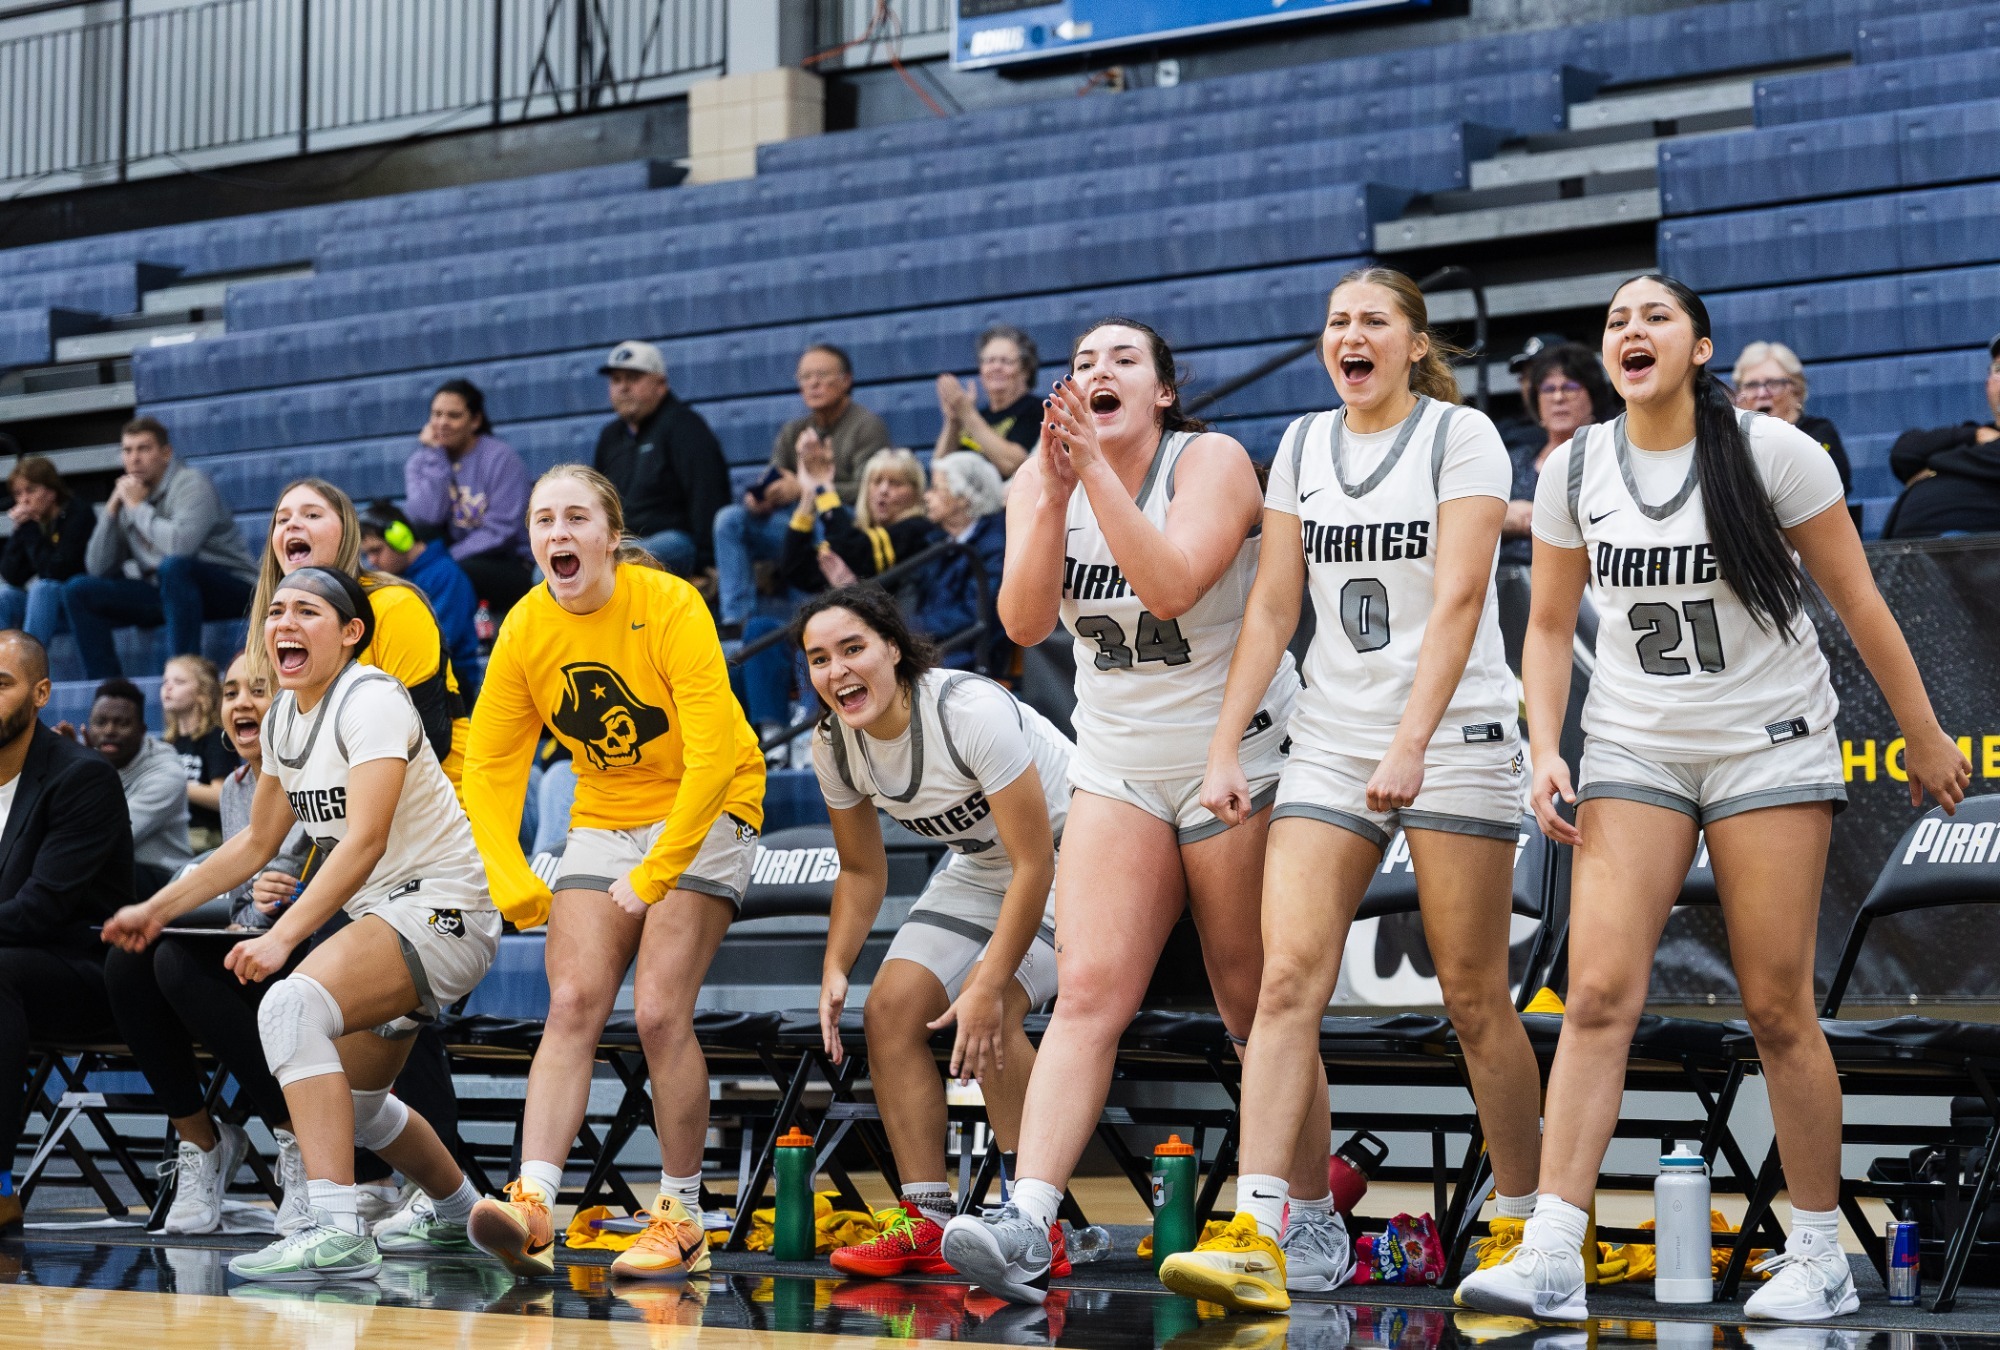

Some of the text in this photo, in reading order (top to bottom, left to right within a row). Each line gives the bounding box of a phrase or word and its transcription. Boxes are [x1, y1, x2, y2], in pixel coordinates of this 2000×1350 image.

[1303, 519, 1430, 565] PIRATES
[1597, 541, 1719, 588] PIRATE
[1340, 578, 1391, 653] 0
[1627, 598, 1726, 676] 21
[1075, 611, 1192, 671] 34
[1491, 728, 1498, 737] L
[1795, 723, 1803, 732] L
